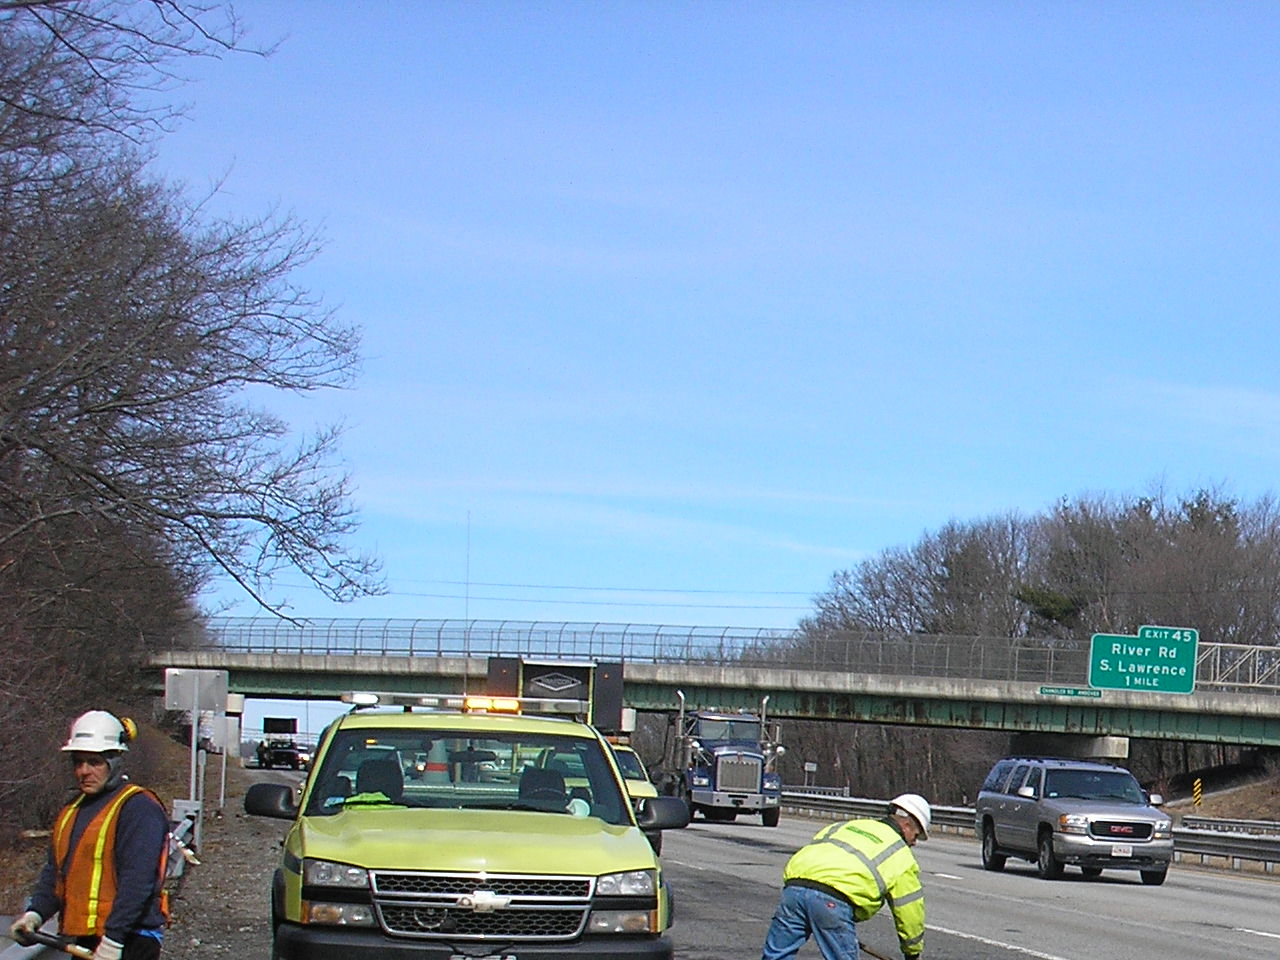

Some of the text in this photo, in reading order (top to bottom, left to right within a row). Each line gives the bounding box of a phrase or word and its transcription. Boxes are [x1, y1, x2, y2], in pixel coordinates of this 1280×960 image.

[1145, 630, 1191, 642] EXIT 45
[1111, 643, 1177, 658] River Rd
[1099, 659, 1187, 676] S. Lawrence
[1125, 676, 1159, 687] 1 MILE
[1110, 825, 1134, 833] GMC
